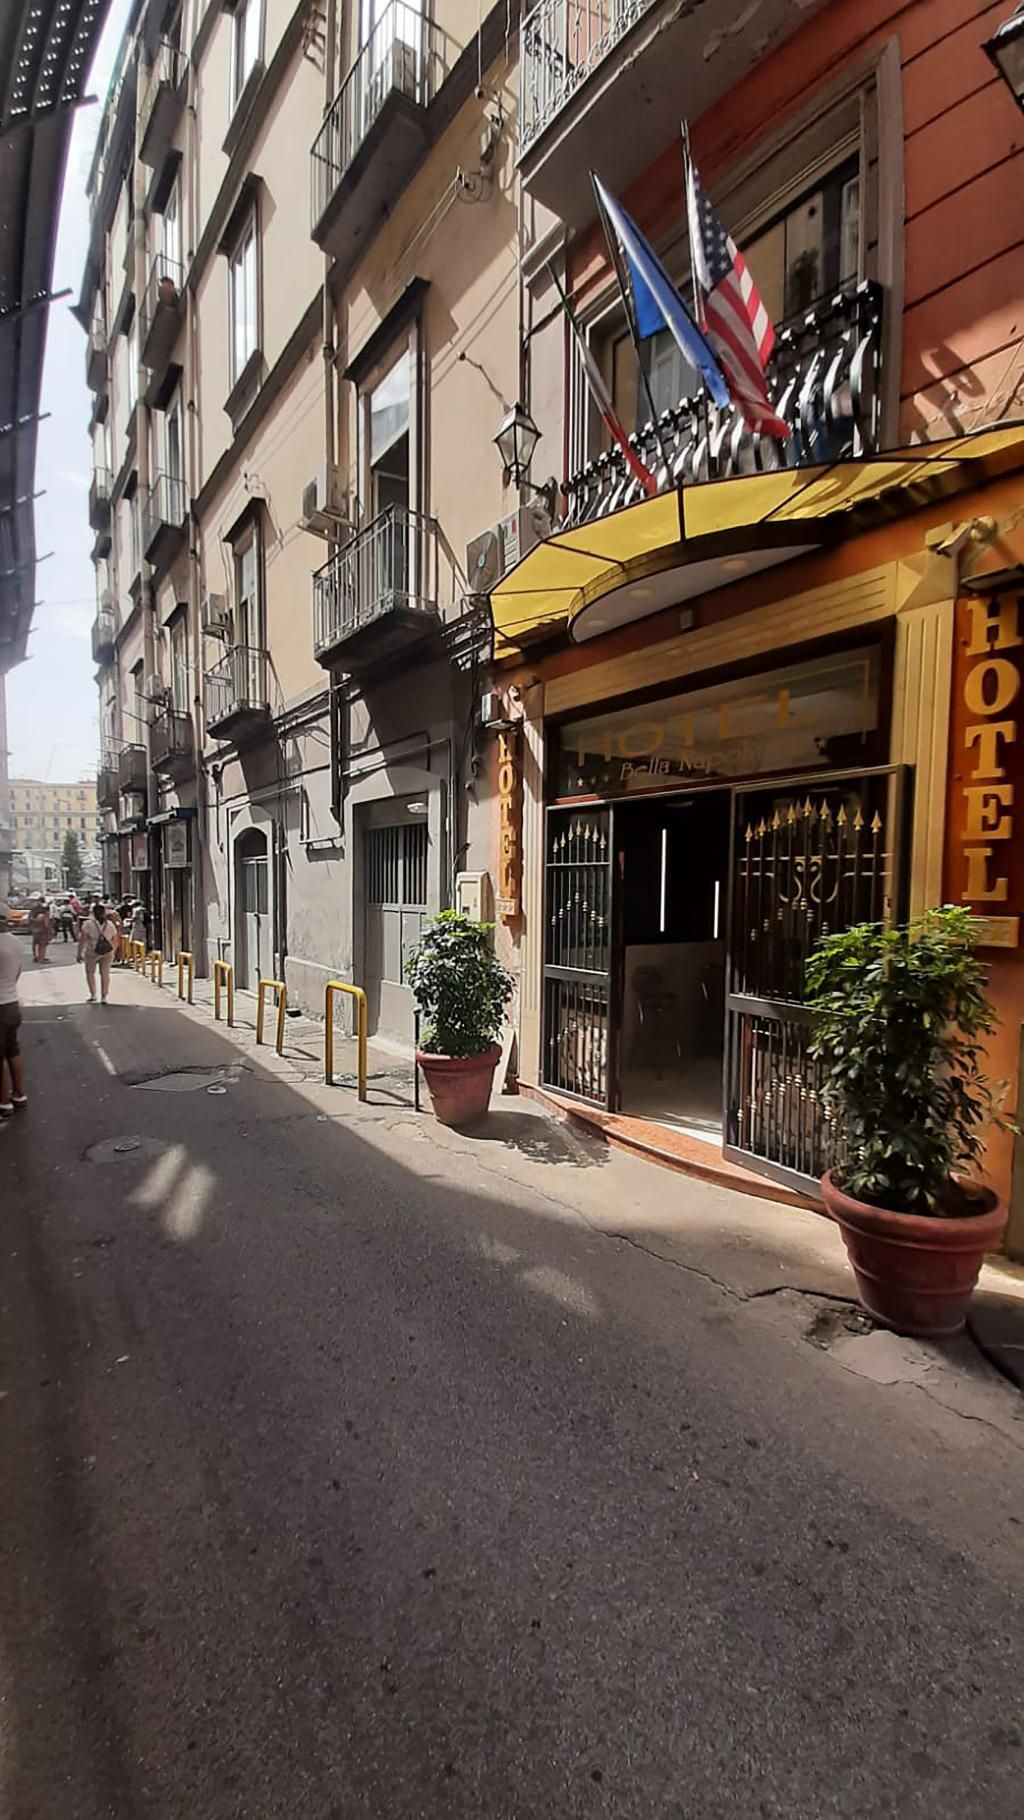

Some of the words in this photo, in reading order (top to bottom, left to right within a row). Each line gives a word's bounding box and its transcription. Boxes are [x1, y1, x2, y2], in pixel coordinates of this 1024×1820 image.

[498, 733, 517, 899] HOTEL
[620, 755, 670, 781] Bella
[961, 596, 1022, 901] HOTEL
